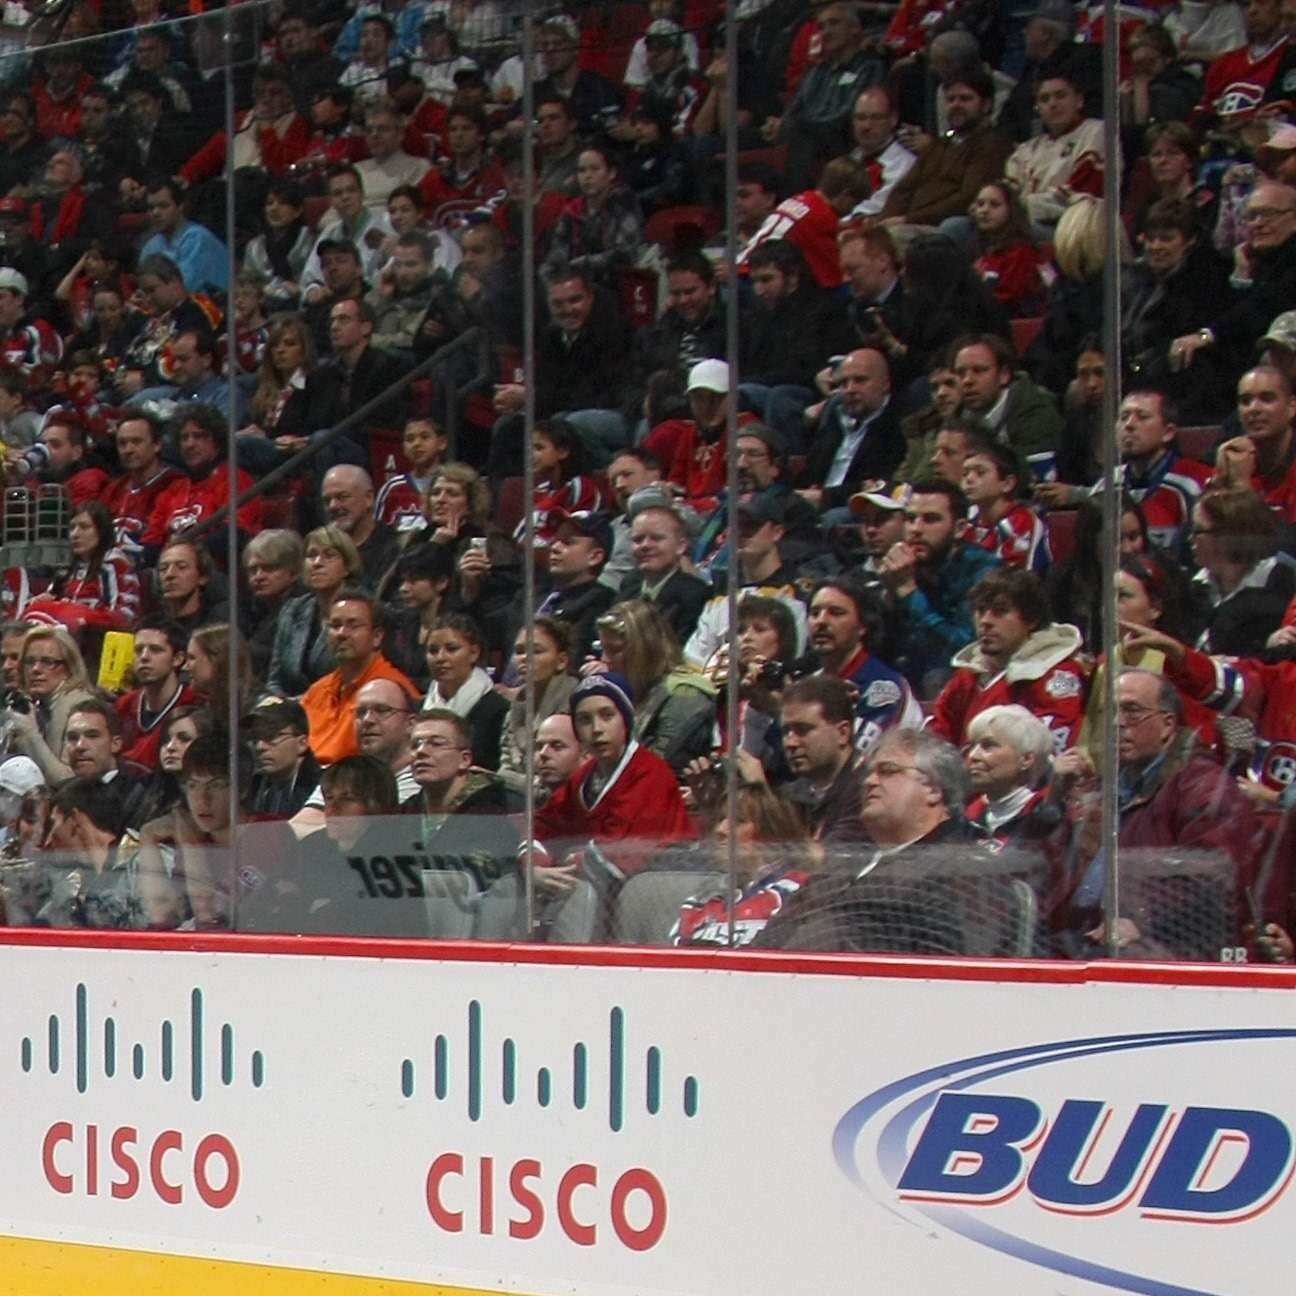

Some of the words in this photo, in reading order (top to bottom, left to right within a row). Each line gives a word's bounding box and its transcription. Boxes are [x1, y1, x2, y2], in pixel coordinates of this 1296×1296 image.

[42, 1121, 241, 1209] CISCO
[426, 1152, 668, 1252] CISCO
[896, 1091, 1296, 1225] BUD
